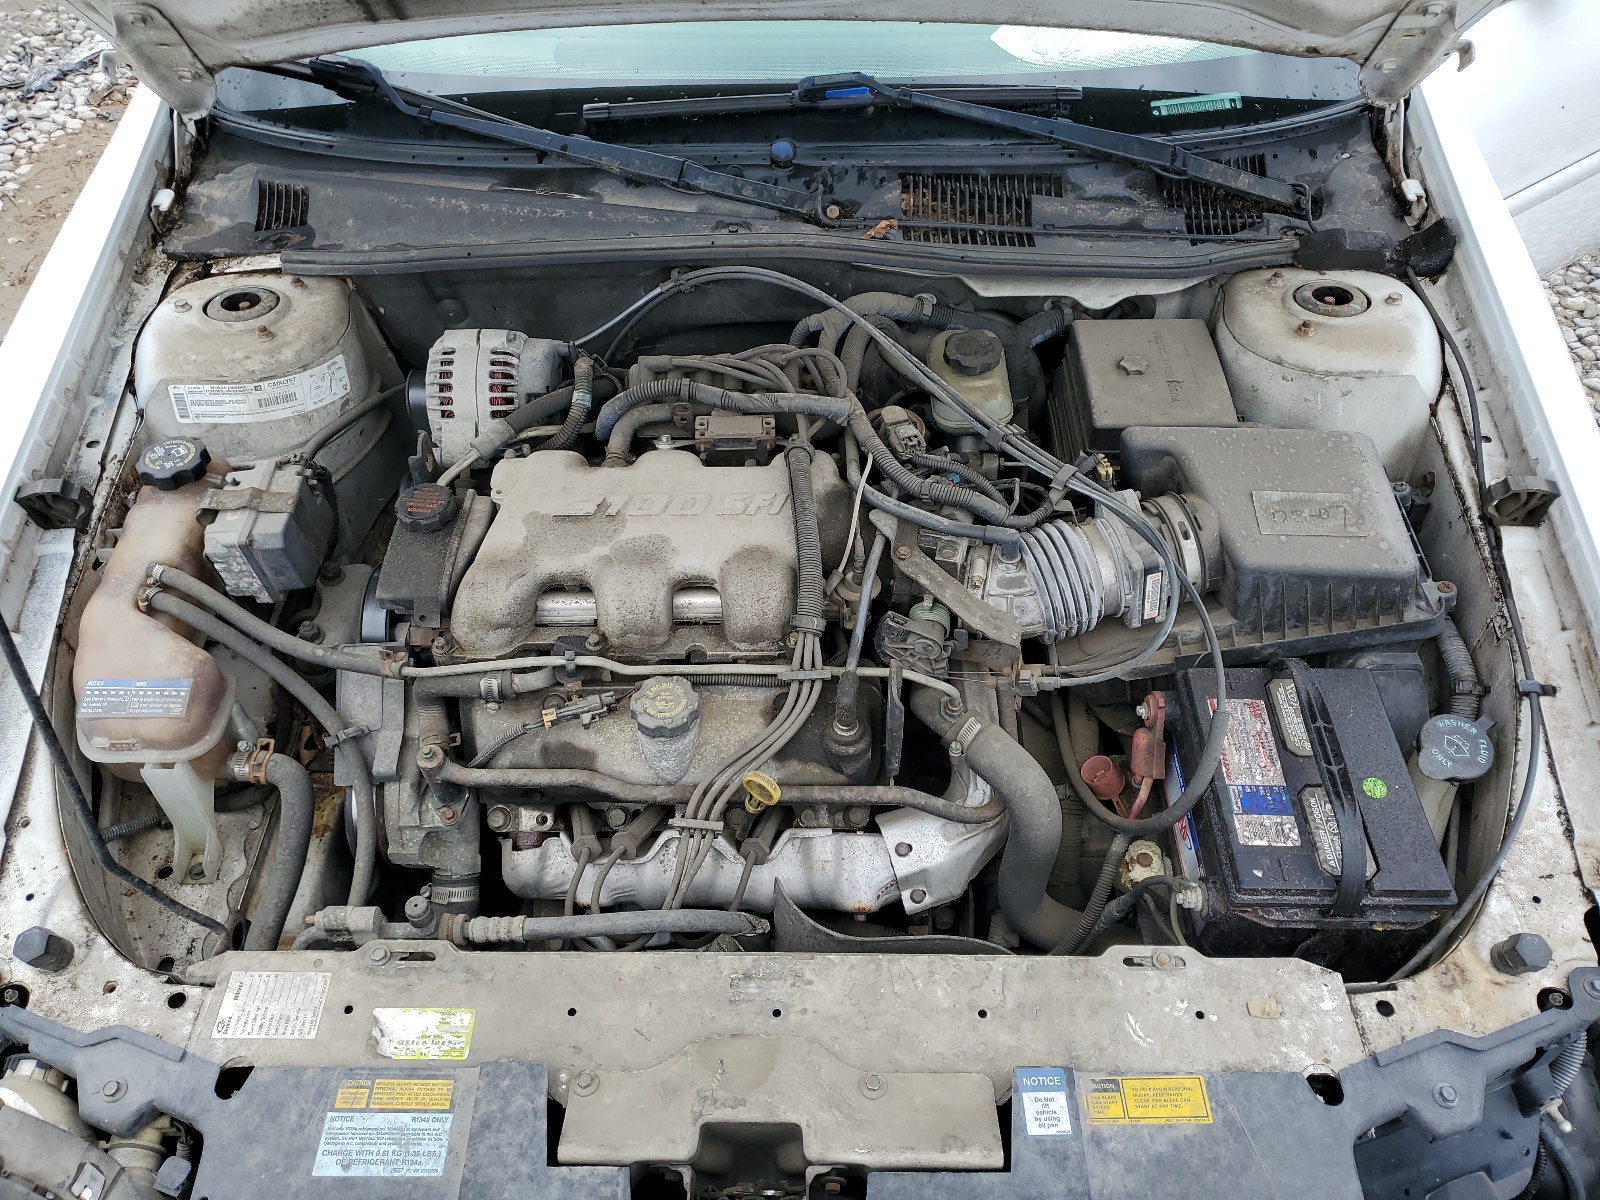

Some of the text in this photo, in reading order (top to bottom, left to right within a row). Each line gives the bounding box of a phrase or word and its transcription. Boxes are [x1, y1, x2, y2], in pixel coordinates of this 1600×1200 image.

[267, 376, 297, 388] CATALYST
[716, 492, 790, 517] SFI
[646, 683, 675, 696] ENGINE
[1431, 719, 1489, 768] WASHER FLUID ONLY
[1309, 797, 1323, 823] POISON
[1319, 830, 1334, 859] DANGER
[1022, 1076, 1062, 1086] NOTICE
[404, 1150, 421, 1158] (1.35
